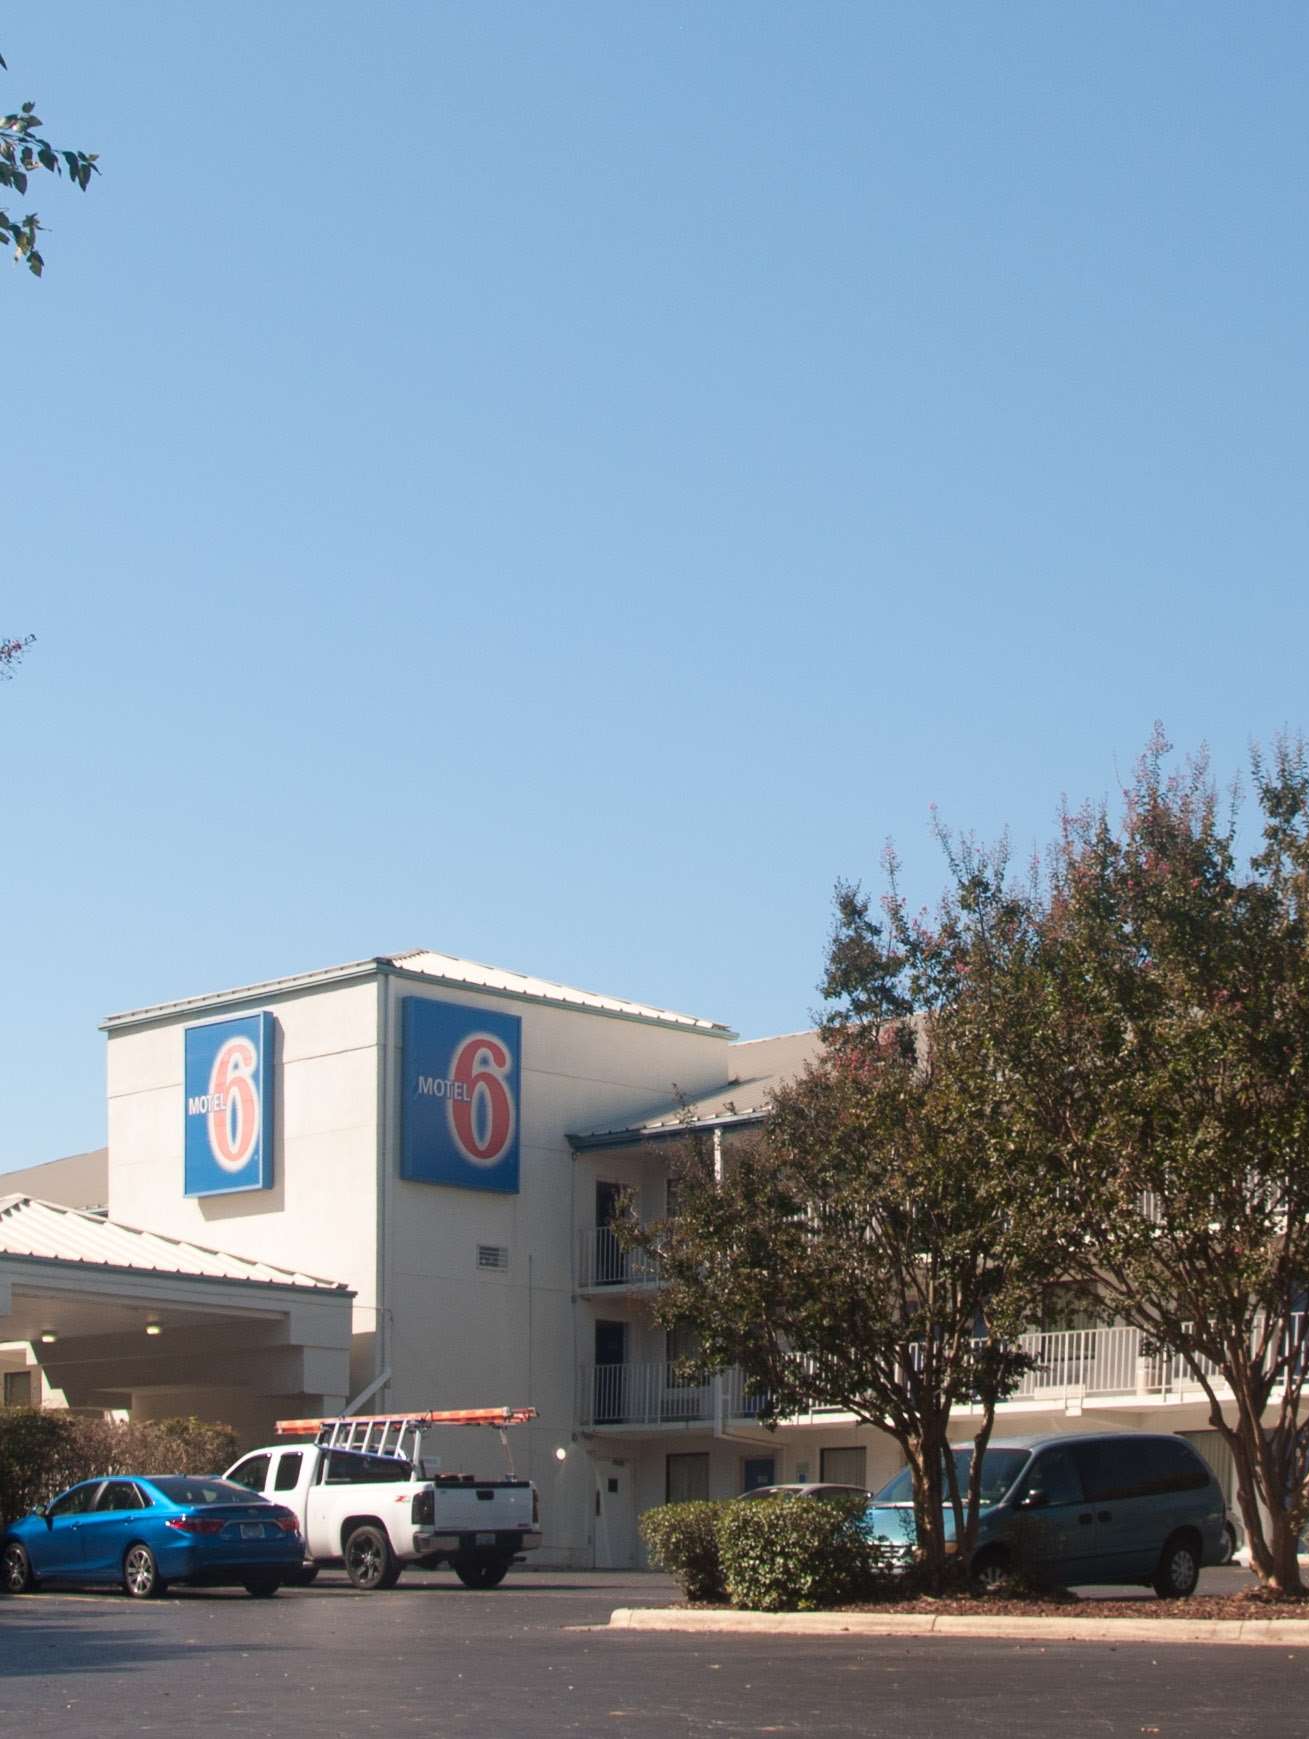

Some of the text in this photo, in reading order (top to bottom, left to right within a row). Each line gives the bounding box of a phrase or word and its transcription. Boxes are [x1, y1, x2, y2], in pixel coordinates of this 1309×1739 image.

[188, 1035, 259, 1173] MOTEL 6
[418, 1032, 514, 1167] MOTEL 6
